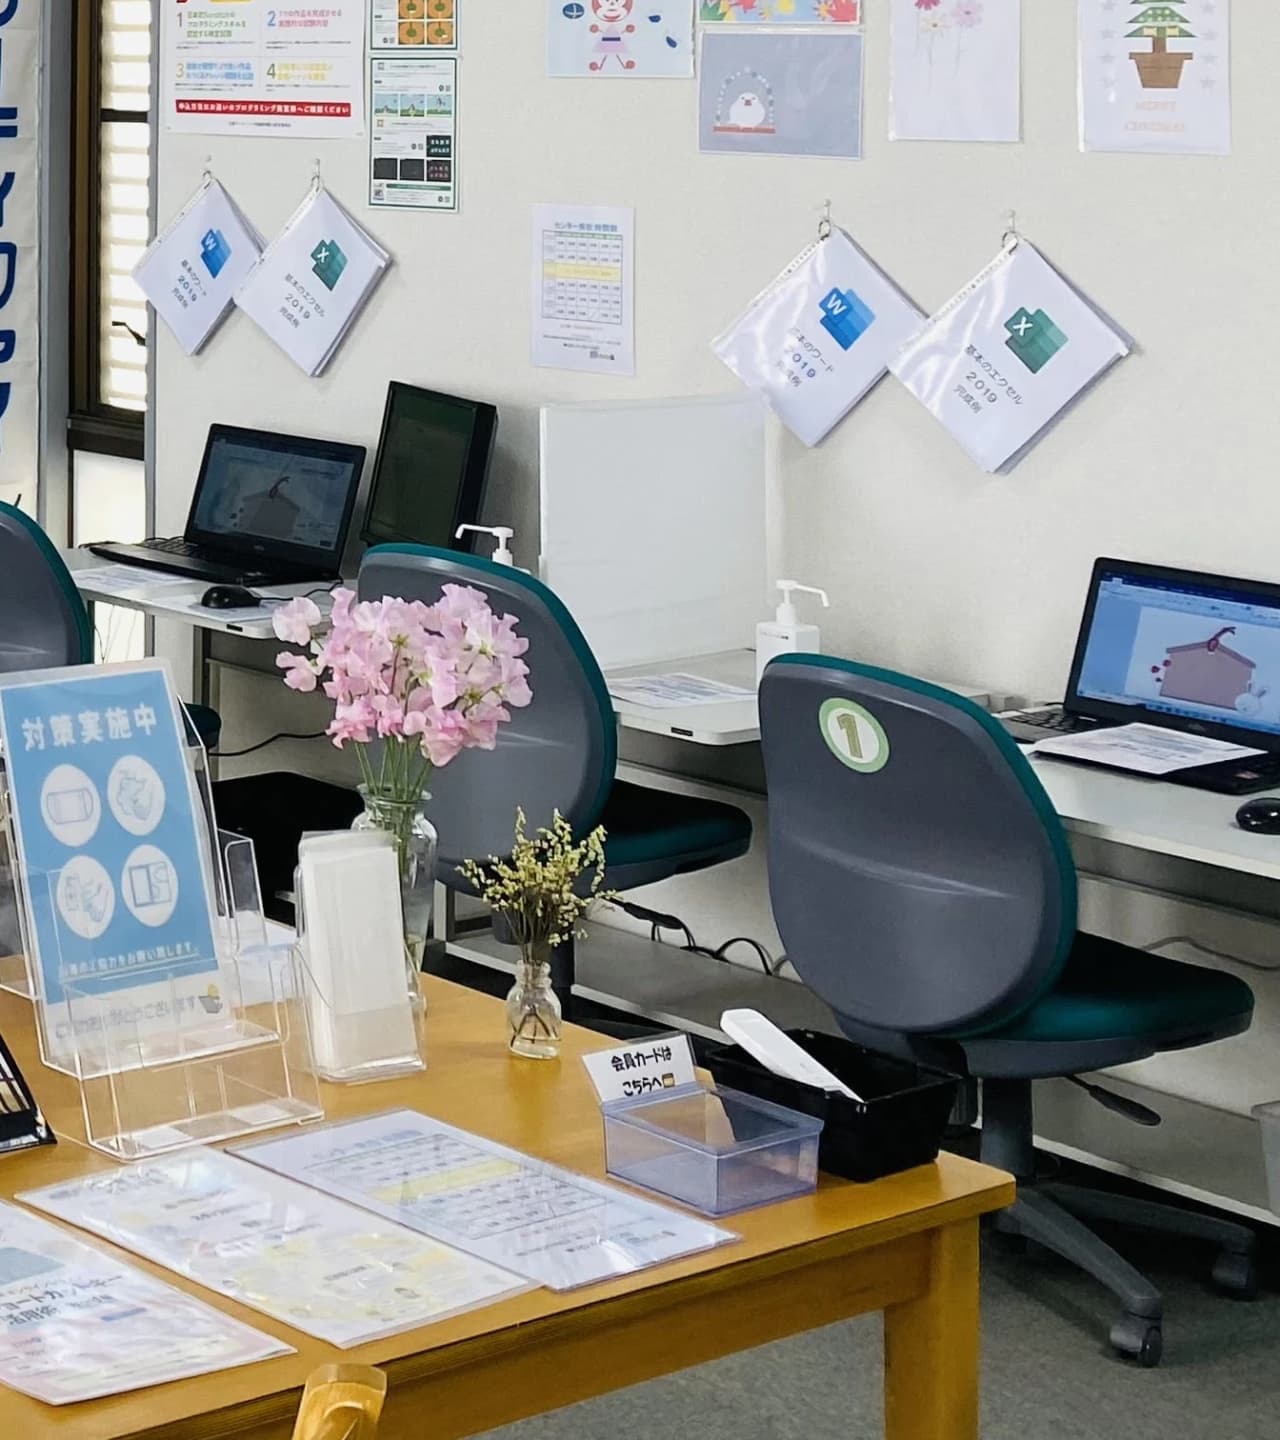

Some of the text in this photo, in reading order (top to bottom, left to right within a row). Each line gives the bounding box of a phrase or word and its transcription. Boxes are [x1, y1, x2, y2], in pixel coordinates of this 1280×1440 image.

[205, 237, 218, 251] W
[317, 246, 330, 263] X
[285, 293, 311, 320] 2019
[826, 296, 847, 316] W
[1013, 317, 1033, 337] X
[964, 371, 997, 405] 2019
[965, 343, 1023, 407] 基本のエクセル
[22, 703, 157, 752] 対策実施中
[837, 712, 863, 759] 1
[610, 1046, 672, 1072] 会員カードは
[622, 1076, 662, 1097] こちらへ
